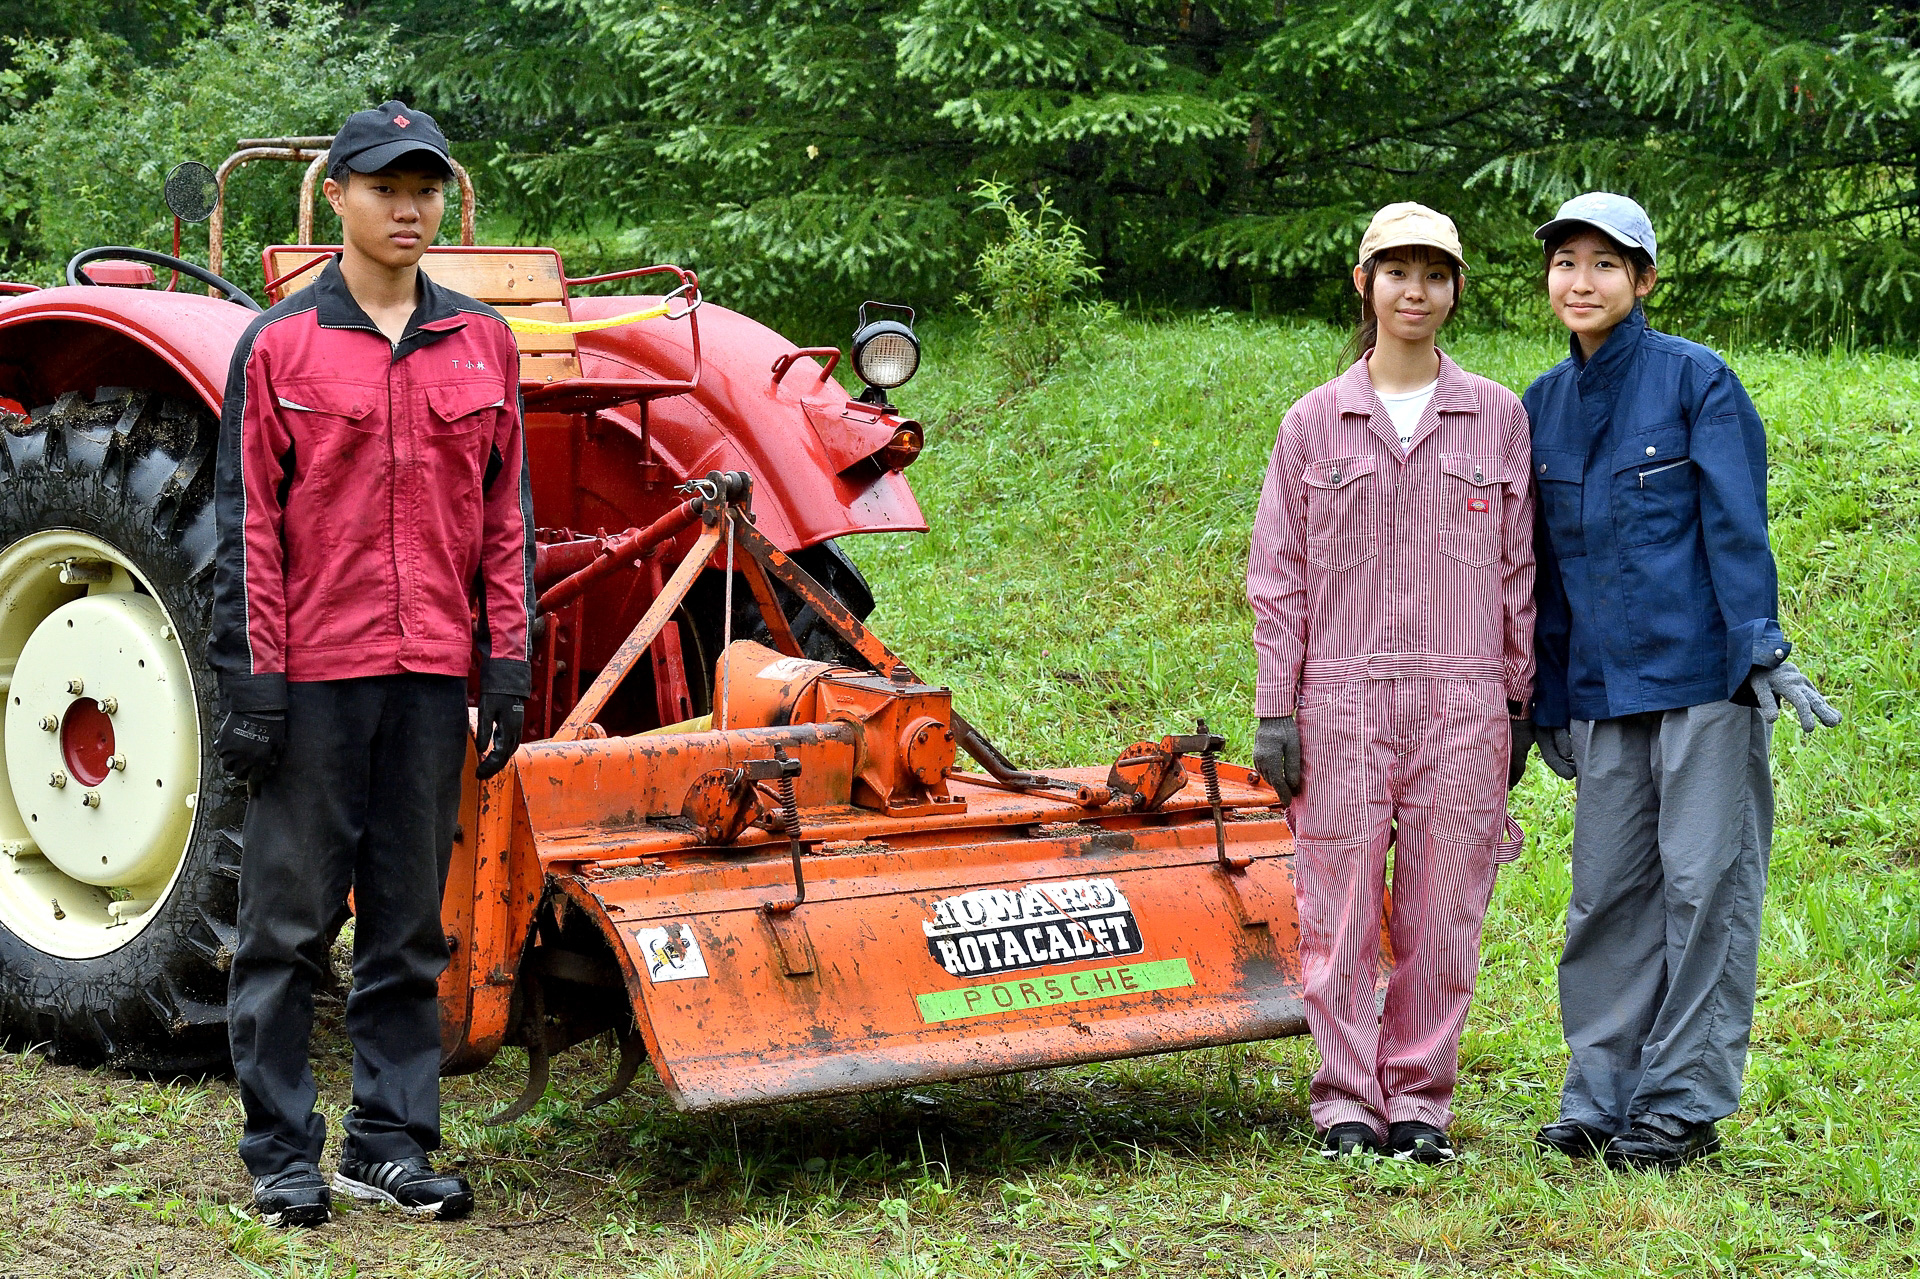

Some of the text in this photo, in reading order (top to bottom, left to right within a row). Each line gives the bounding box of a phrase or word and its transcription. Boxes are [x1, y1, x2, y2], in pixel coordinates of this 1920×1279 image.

[465, 359, 486, 371] 小林
[935, 915, 1131, 975] ROTACADET
[963, 968, 1140, 1012] PORSCHE
